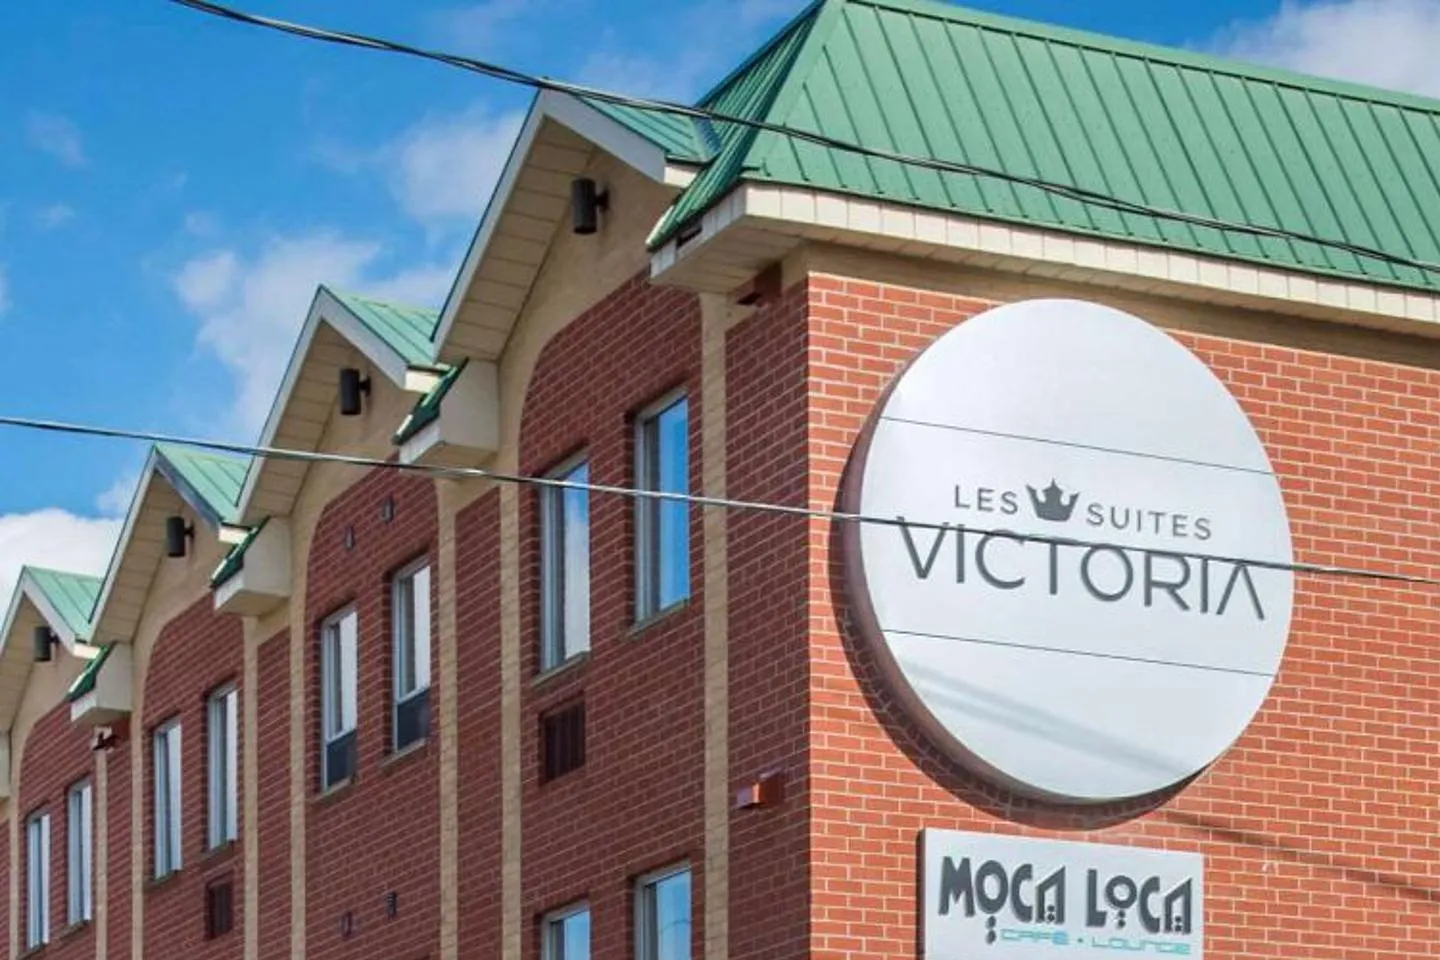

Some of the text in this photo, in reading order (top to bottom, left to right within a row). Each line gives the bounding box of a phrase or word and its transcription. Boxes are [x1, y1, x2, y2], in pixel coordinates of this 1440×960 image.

[954, 484, 1212, 541] LES SUITES
[896, 516, 1266, 620] VICTORIA
[938, 856, 1193, 935] MOCA LOCA
